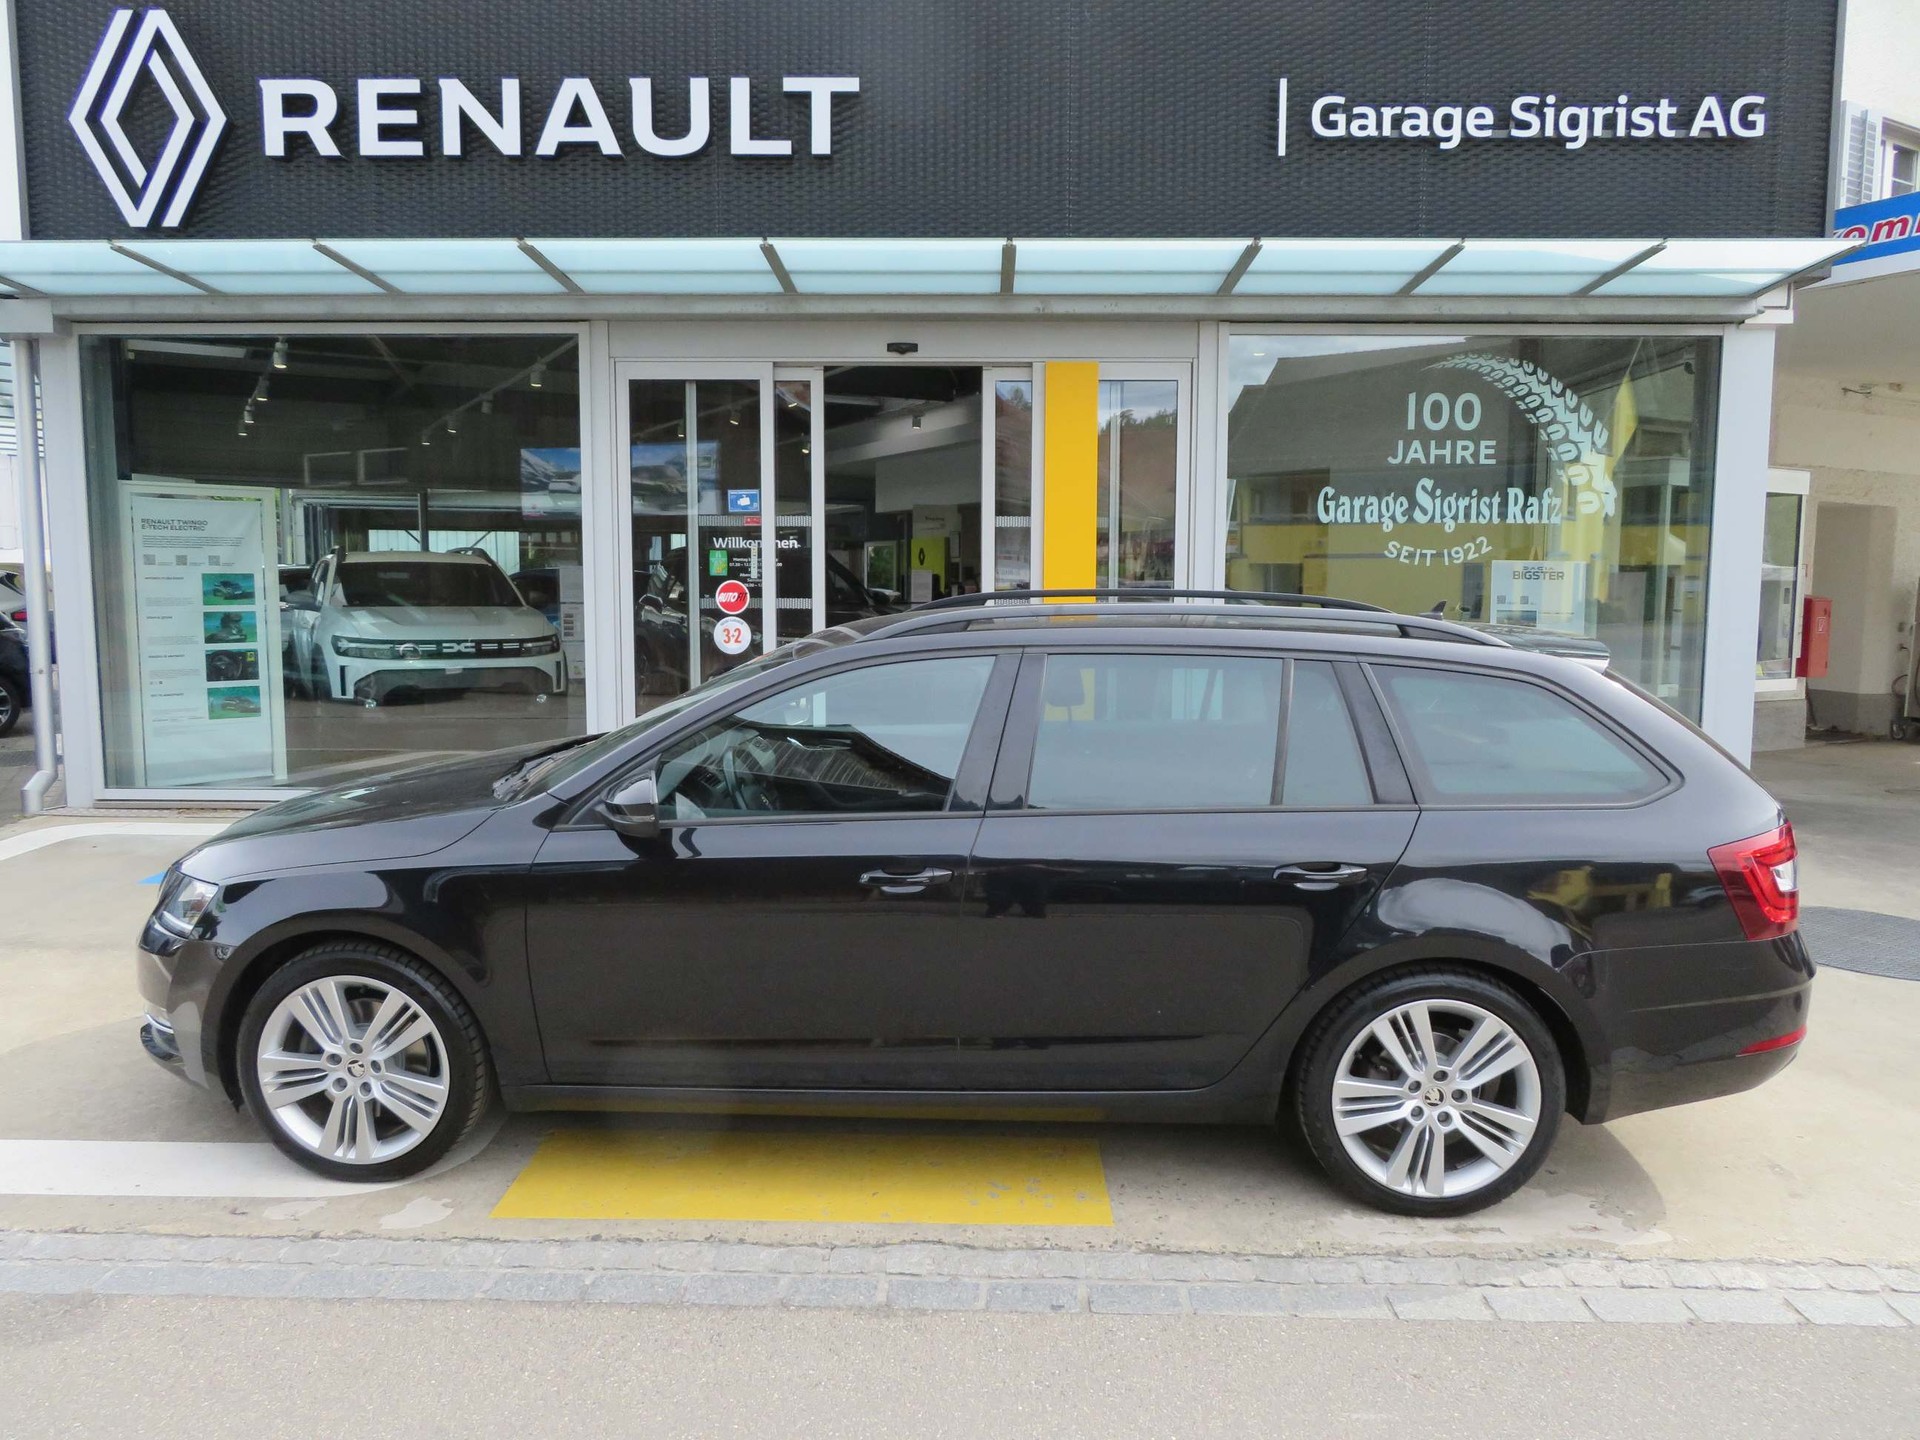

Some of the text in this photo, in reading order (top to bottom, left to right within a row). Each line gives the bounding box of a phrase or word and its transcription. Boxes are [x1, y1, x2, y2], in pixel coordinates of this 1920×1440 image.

[258, 76, 860, 157] RENAULT
[1310, 94, 1766, 150] Garage Sigrist AG
[1407, 391, 1482, 431] 100
[1387, 439, 1497, 465] JAHRE
[141, 518, 208, 527] RENAULT TWINGO
[1317, 477, 1562, 533] Garage Sigrist Rafz
[1384, 536, 1493, 567] SEIT 1922
[1512, 570, 1565, 581] BIGSTER
